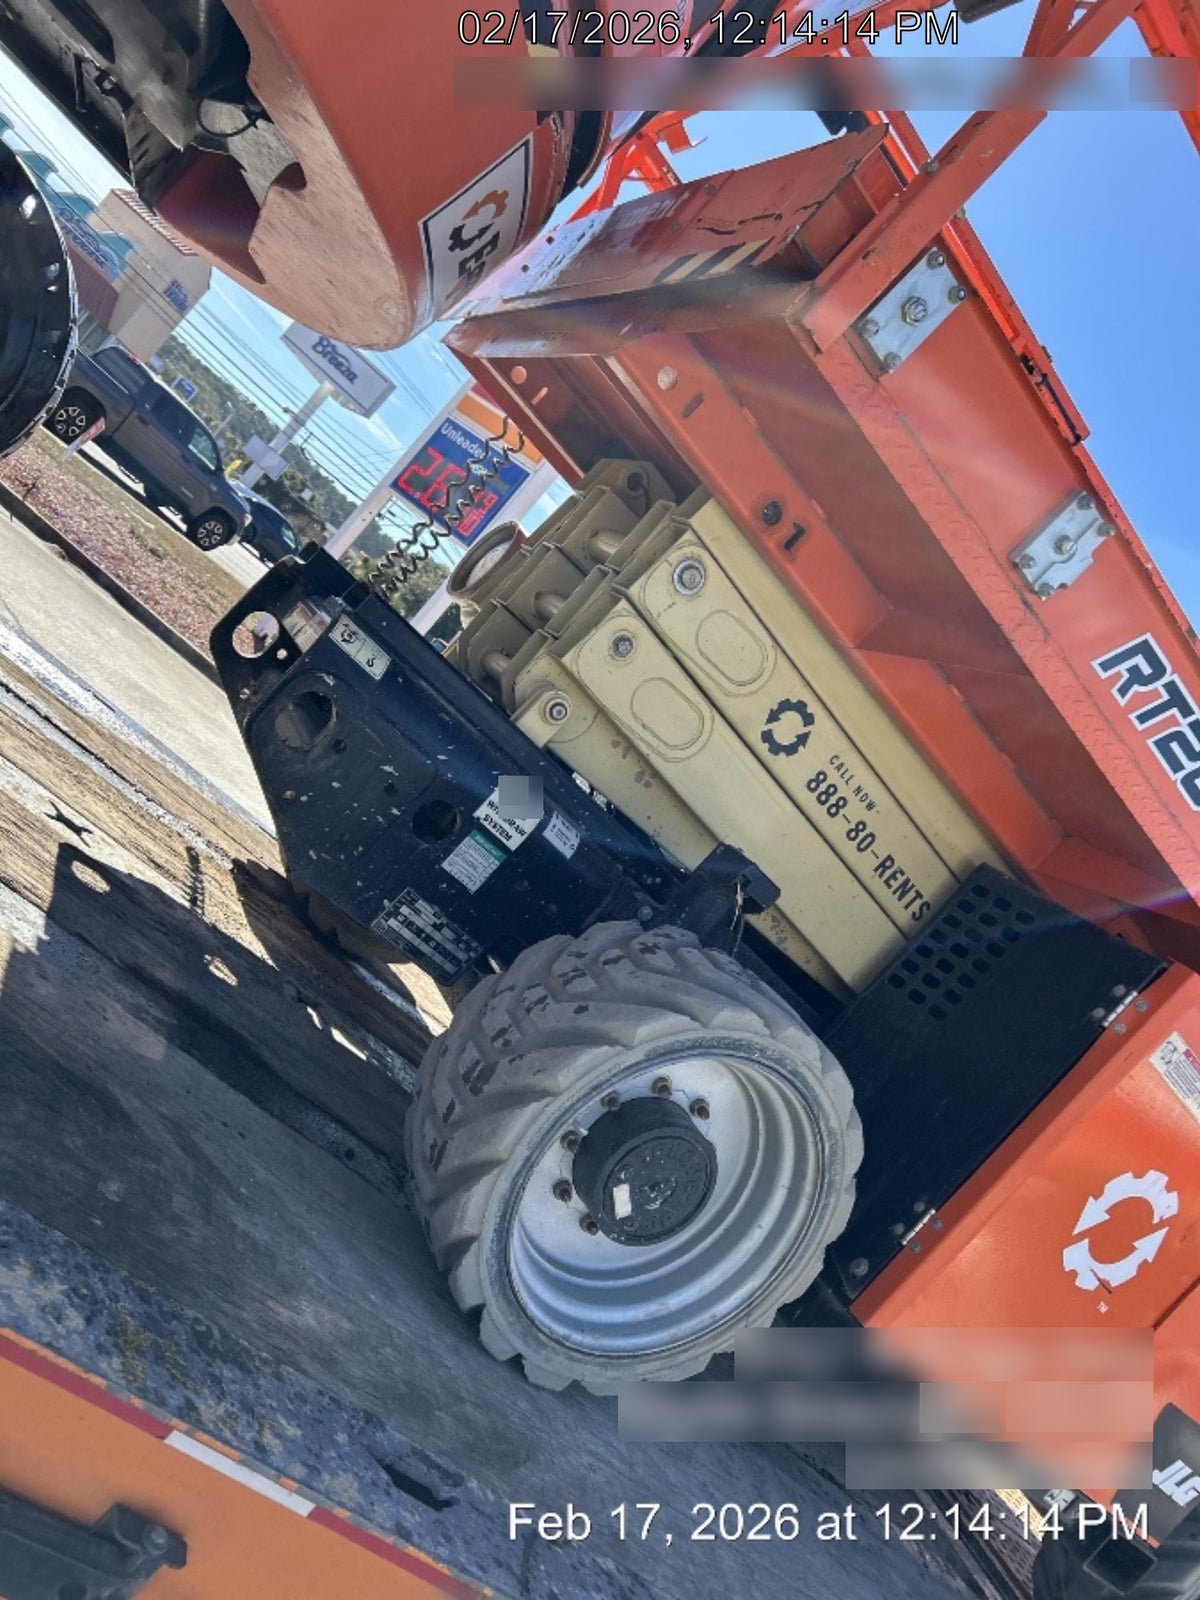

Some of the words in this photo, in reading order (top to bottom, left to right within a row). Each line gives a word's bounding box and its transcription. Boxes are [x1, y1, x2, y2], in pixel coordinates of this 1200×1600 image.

[829, 754, 855, 786] CALL
[852, 784, 877, 812] NOW
[482, 813, 513, 841] SYSTEM
[806, 769, 931, 922] 888-80-RENTS
